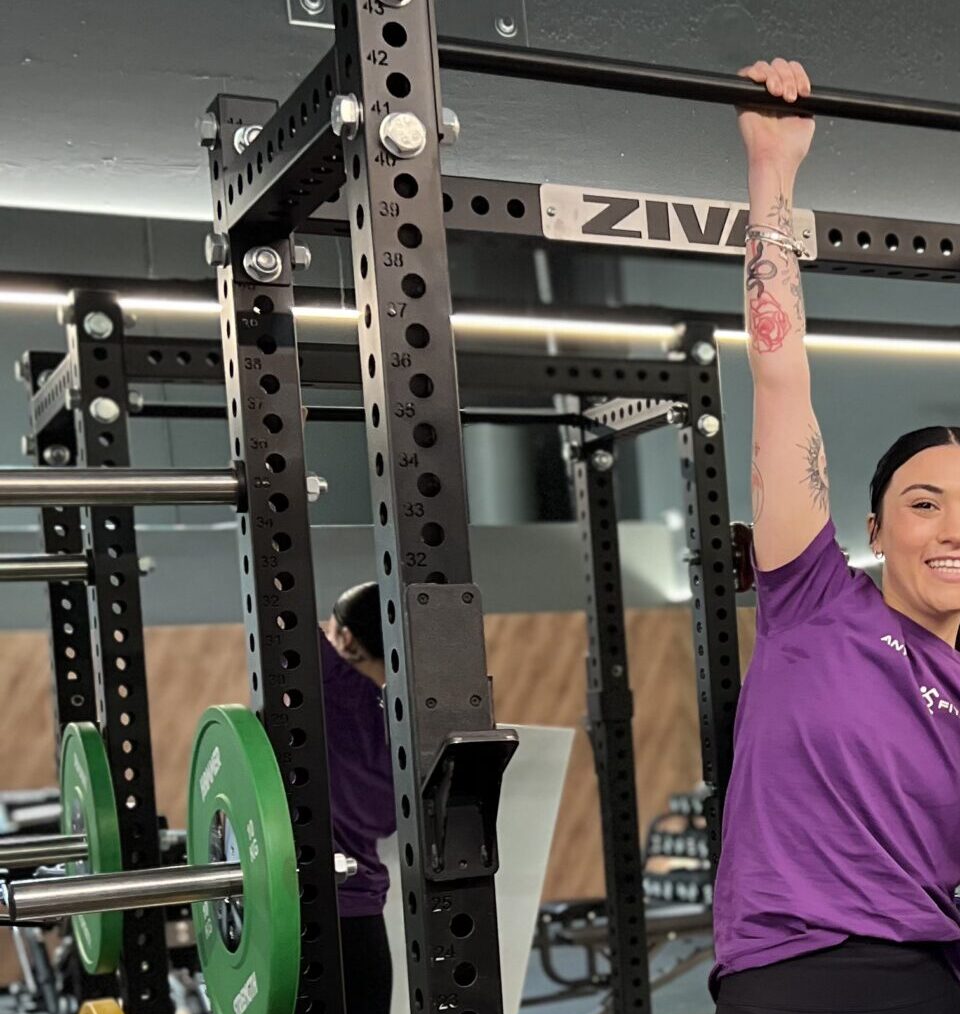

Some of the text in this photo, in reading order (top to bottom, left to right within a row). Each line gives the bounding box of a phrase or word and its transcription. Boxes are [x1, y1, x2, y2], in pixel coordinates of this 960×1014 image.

[366, 51, 388, 66] 42
[371, 101, 391, 115] 41
[380, 202, 400, 218] 39
[383, 252, 404, 267] 38
[387, 303, 406, 318] 37
[244, 356, 261, 370] 38
[391, 353, 412, 367] 36
[394, 404, 416, 418] 35
[398, 453, 419, 468] 34
[404, 503, 425, 518] 33
[261, 556, 278, 568] 33
[406, 553, 427, 567] 32
